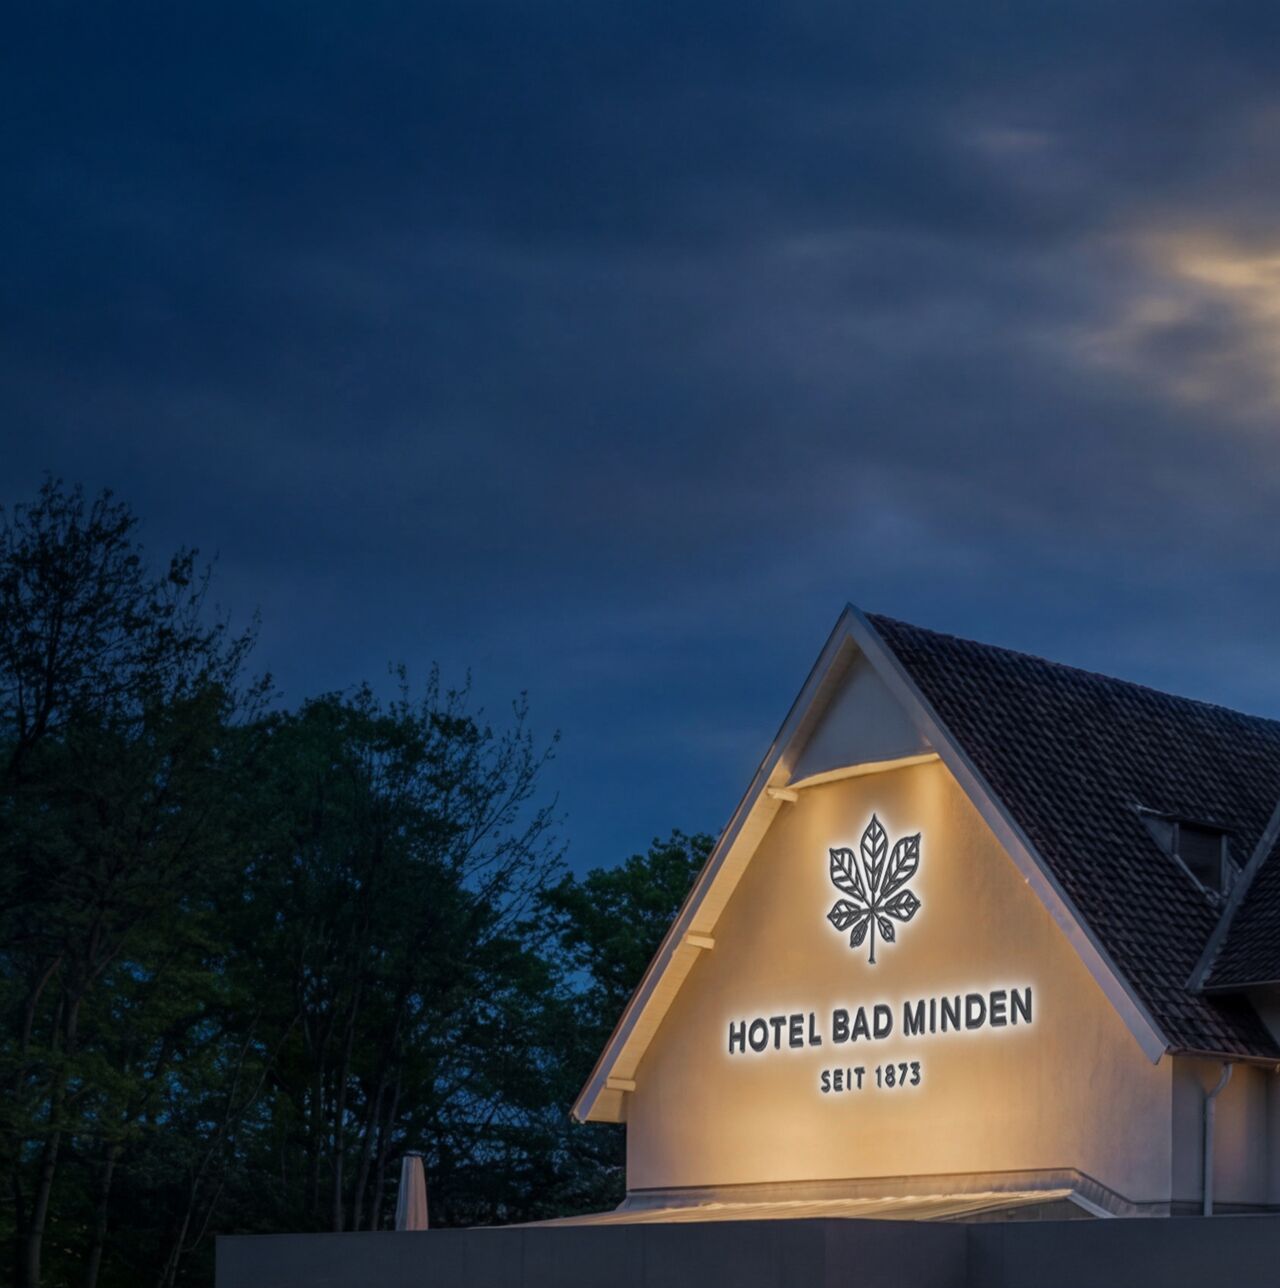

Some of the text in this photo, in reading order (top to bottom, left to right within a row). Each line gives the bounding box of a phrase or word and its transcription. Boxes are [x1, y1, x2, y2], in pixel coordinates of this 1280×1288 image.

[728, 987, 1032, 1054] HOTEL BAD MINDEN
[820, 1061, 921, 1093] SEIT 1873
